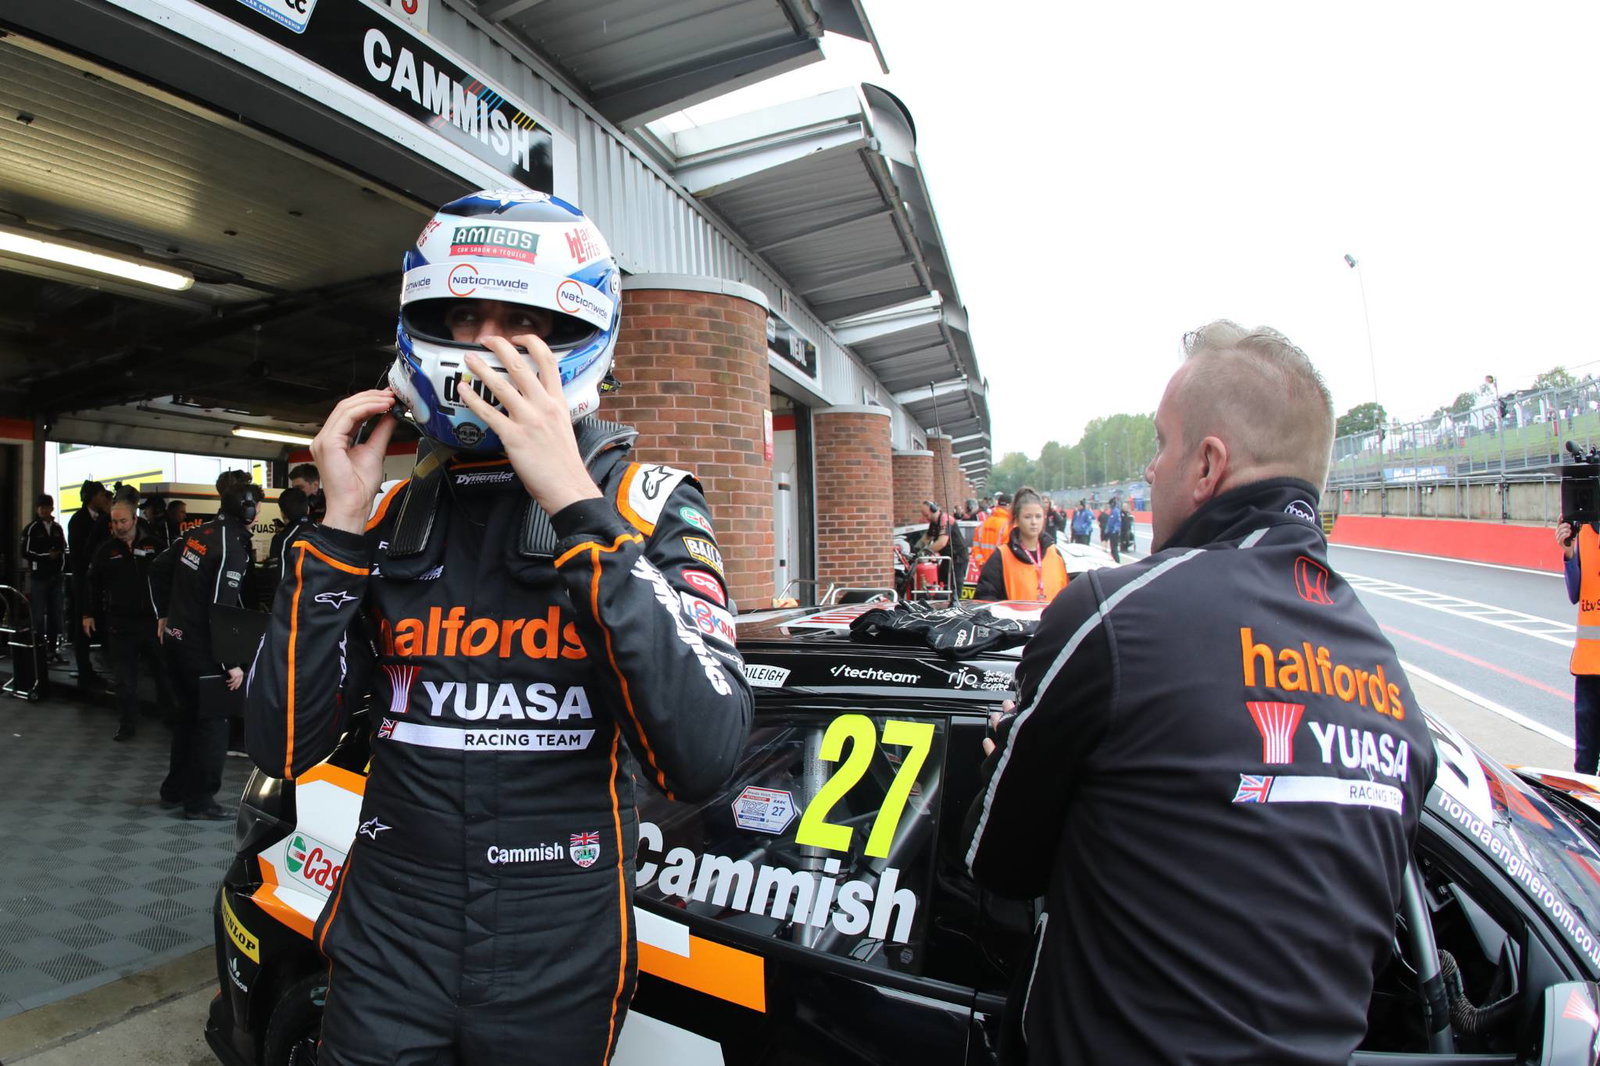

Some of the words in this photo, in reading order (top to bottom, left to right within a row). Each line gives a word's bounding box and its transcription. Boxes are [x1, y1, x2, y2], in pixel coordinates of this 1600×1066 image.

[363, 28, 530, 172] CAMMISH
[455, 227, 534, 249] AMIGOS
[406, 277, 431, 291] onwide
[453, 275, 529, 290] Nationwide
[561, 290, 608, 319] Nationwide
[251, 523, 277, 534] YUAS
[745, 666, 785, 682] AILEIGH
[1240, 627, 1405, 721] halfords
[422, 681, 593, 720] YUASA
[464, 733, 530, 747] RACING
[536, 733, 581, 746] TEAM
[1308, 721, 1410, 783] YUASA
[795, 714, 935, 859] 27
[1350, 784, 1388, 803] RACING
[771, 806, 785, 817] 27
[487, 842, 564, 864] Cammish
[303, 847, 342, 891] Cas
[1438, 791, 1600, 969] hondaengineroom.co.u
[635, 822, 917, 944] Cammish
